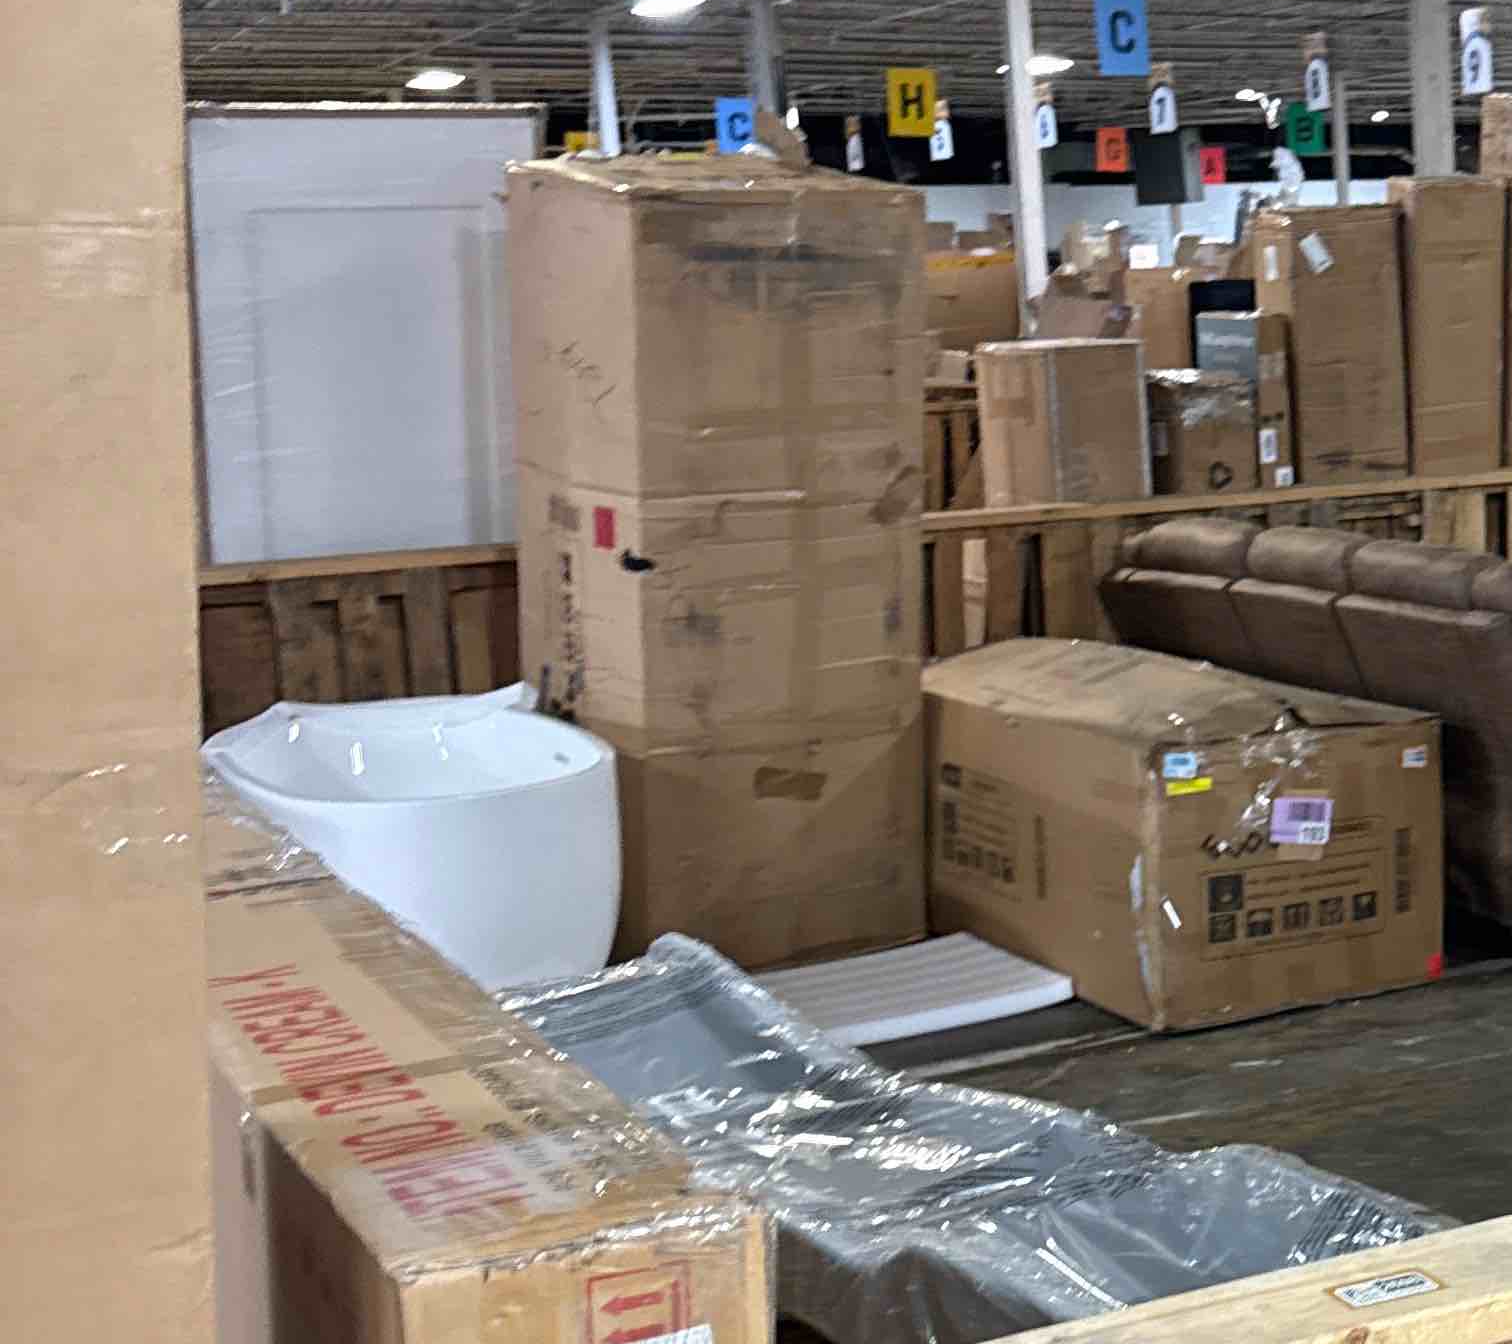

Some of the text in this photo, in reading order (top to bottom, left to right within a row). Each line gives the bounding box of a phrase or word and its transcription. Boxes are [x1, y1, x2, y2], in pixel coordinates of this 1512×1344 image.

[1109, 9, 1135, 54] C
[900, 83, 923, 119] H
[727, 112, 750, 141] C
